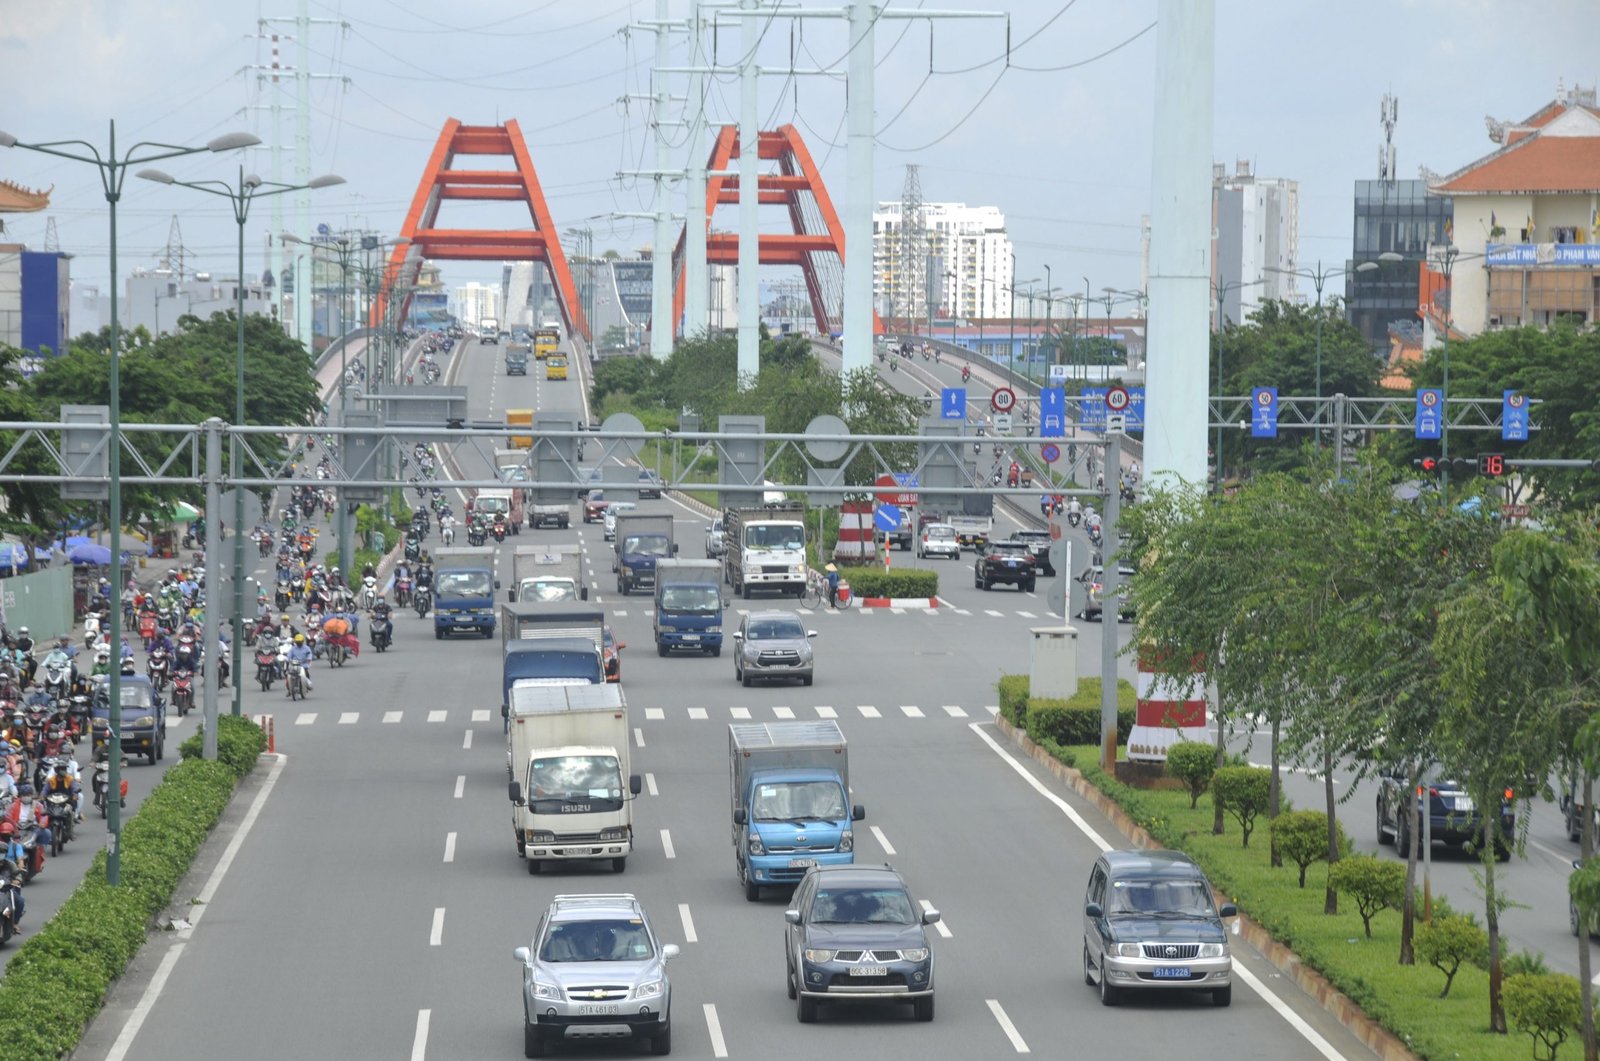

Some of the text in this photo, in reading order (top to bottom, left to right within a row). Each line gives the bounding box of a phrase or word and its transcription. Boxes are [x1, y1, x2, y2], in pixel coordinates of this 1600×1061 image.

[998, 393, 1009, 405] 80
[1112, 393, 1122, 404] 60
[1261, 394, 1269, 402] 50
[1425, 395, 1433, 403] 50
[1487, 455, 1502, 475] 16
[561, 804, 591, 812] ISUZU
